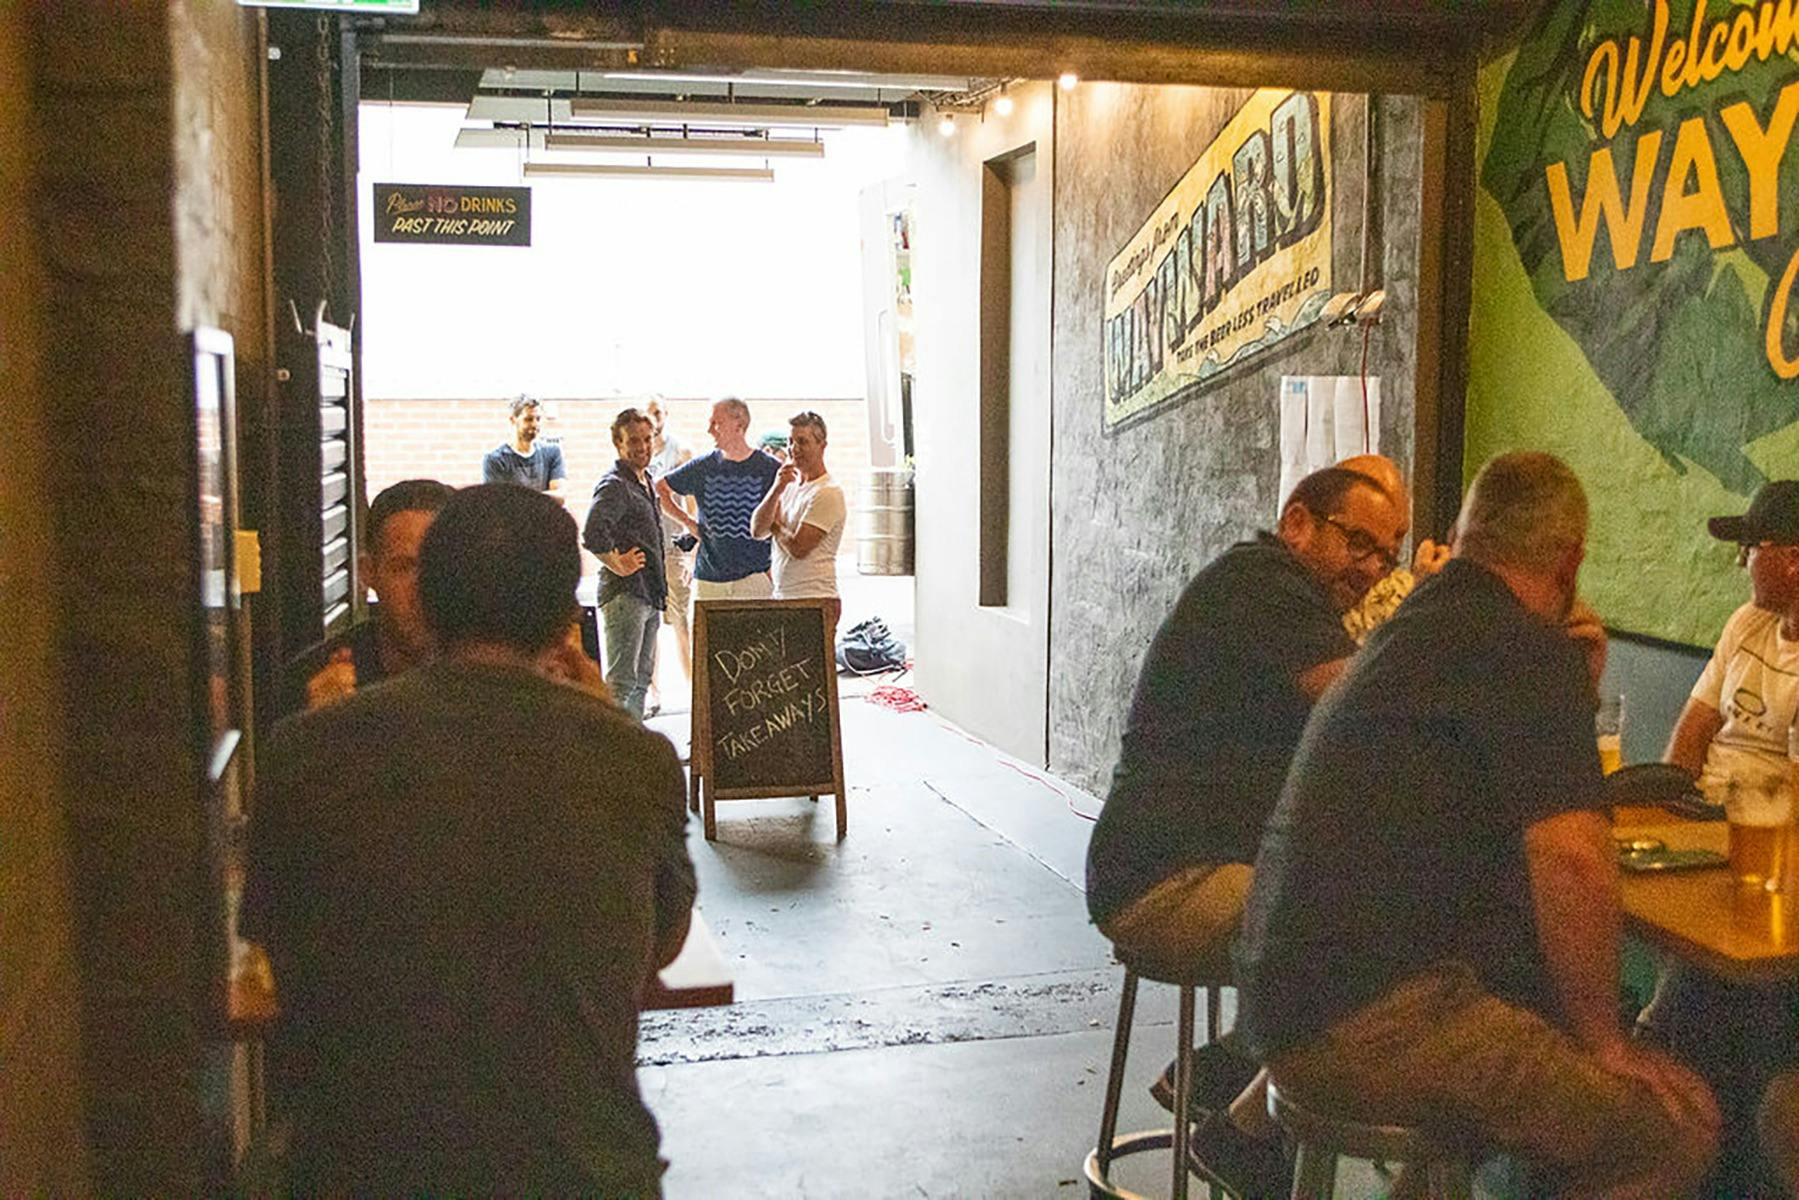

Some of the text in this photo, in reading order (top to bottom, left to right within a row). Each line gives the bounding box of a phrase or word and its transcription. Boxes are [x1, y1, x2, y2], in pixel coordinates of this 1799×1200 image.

[391, 216, 515, 236] PAST THIS POINT
[427, 195, 459, 213] NO
[460, 196, 517, 214] DRINKS
[1232, 303, 1255, 333] LESS
[1256, 265, 1320, 318] TRAVELLED
[722, 656, 812, 717] FORGET
[717, 686, 827, 761] TAKEAWAYS
